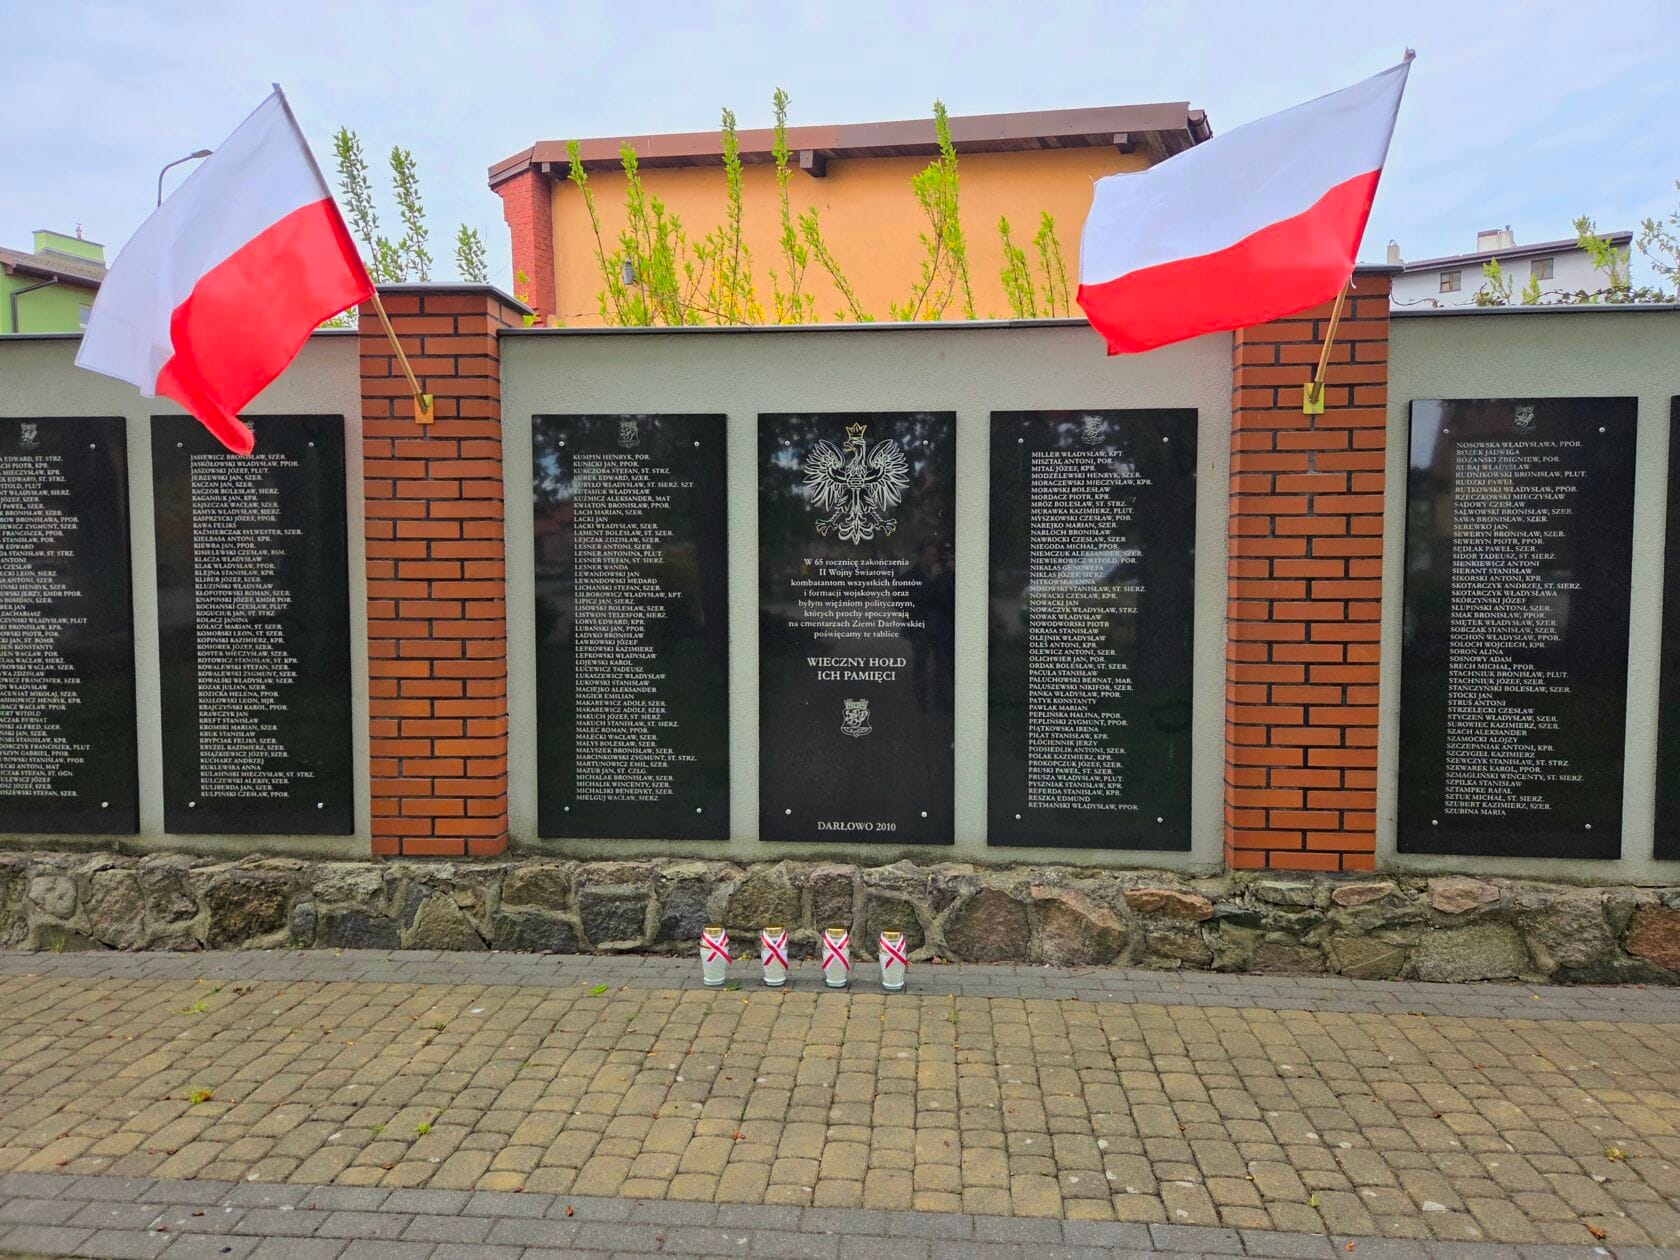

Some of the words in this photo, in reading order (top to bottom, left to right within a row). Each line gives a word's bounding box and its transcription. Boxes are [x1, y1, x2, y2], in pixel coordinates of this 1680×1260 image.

[828, 569, 852, 577] Wojny
[854, 566, 894, 577] Światowej
[847, 579, 890, 588] wszystkich
[809, 589, 841, 598] formacji
[843, 590, 890, 598] wojskowych
[814, 631, 862, 639] poświęcamy
[807, 657, 867, 667] WIECZNY
[869, 657, 906, 667] HOŁD
[818, 671, 840, 680] ICH
[844, 671, 896, 683] PAMIĘCI
[817, 821, 874, 831] DARŁOWO
[876, 822, 896, 832] 2010
